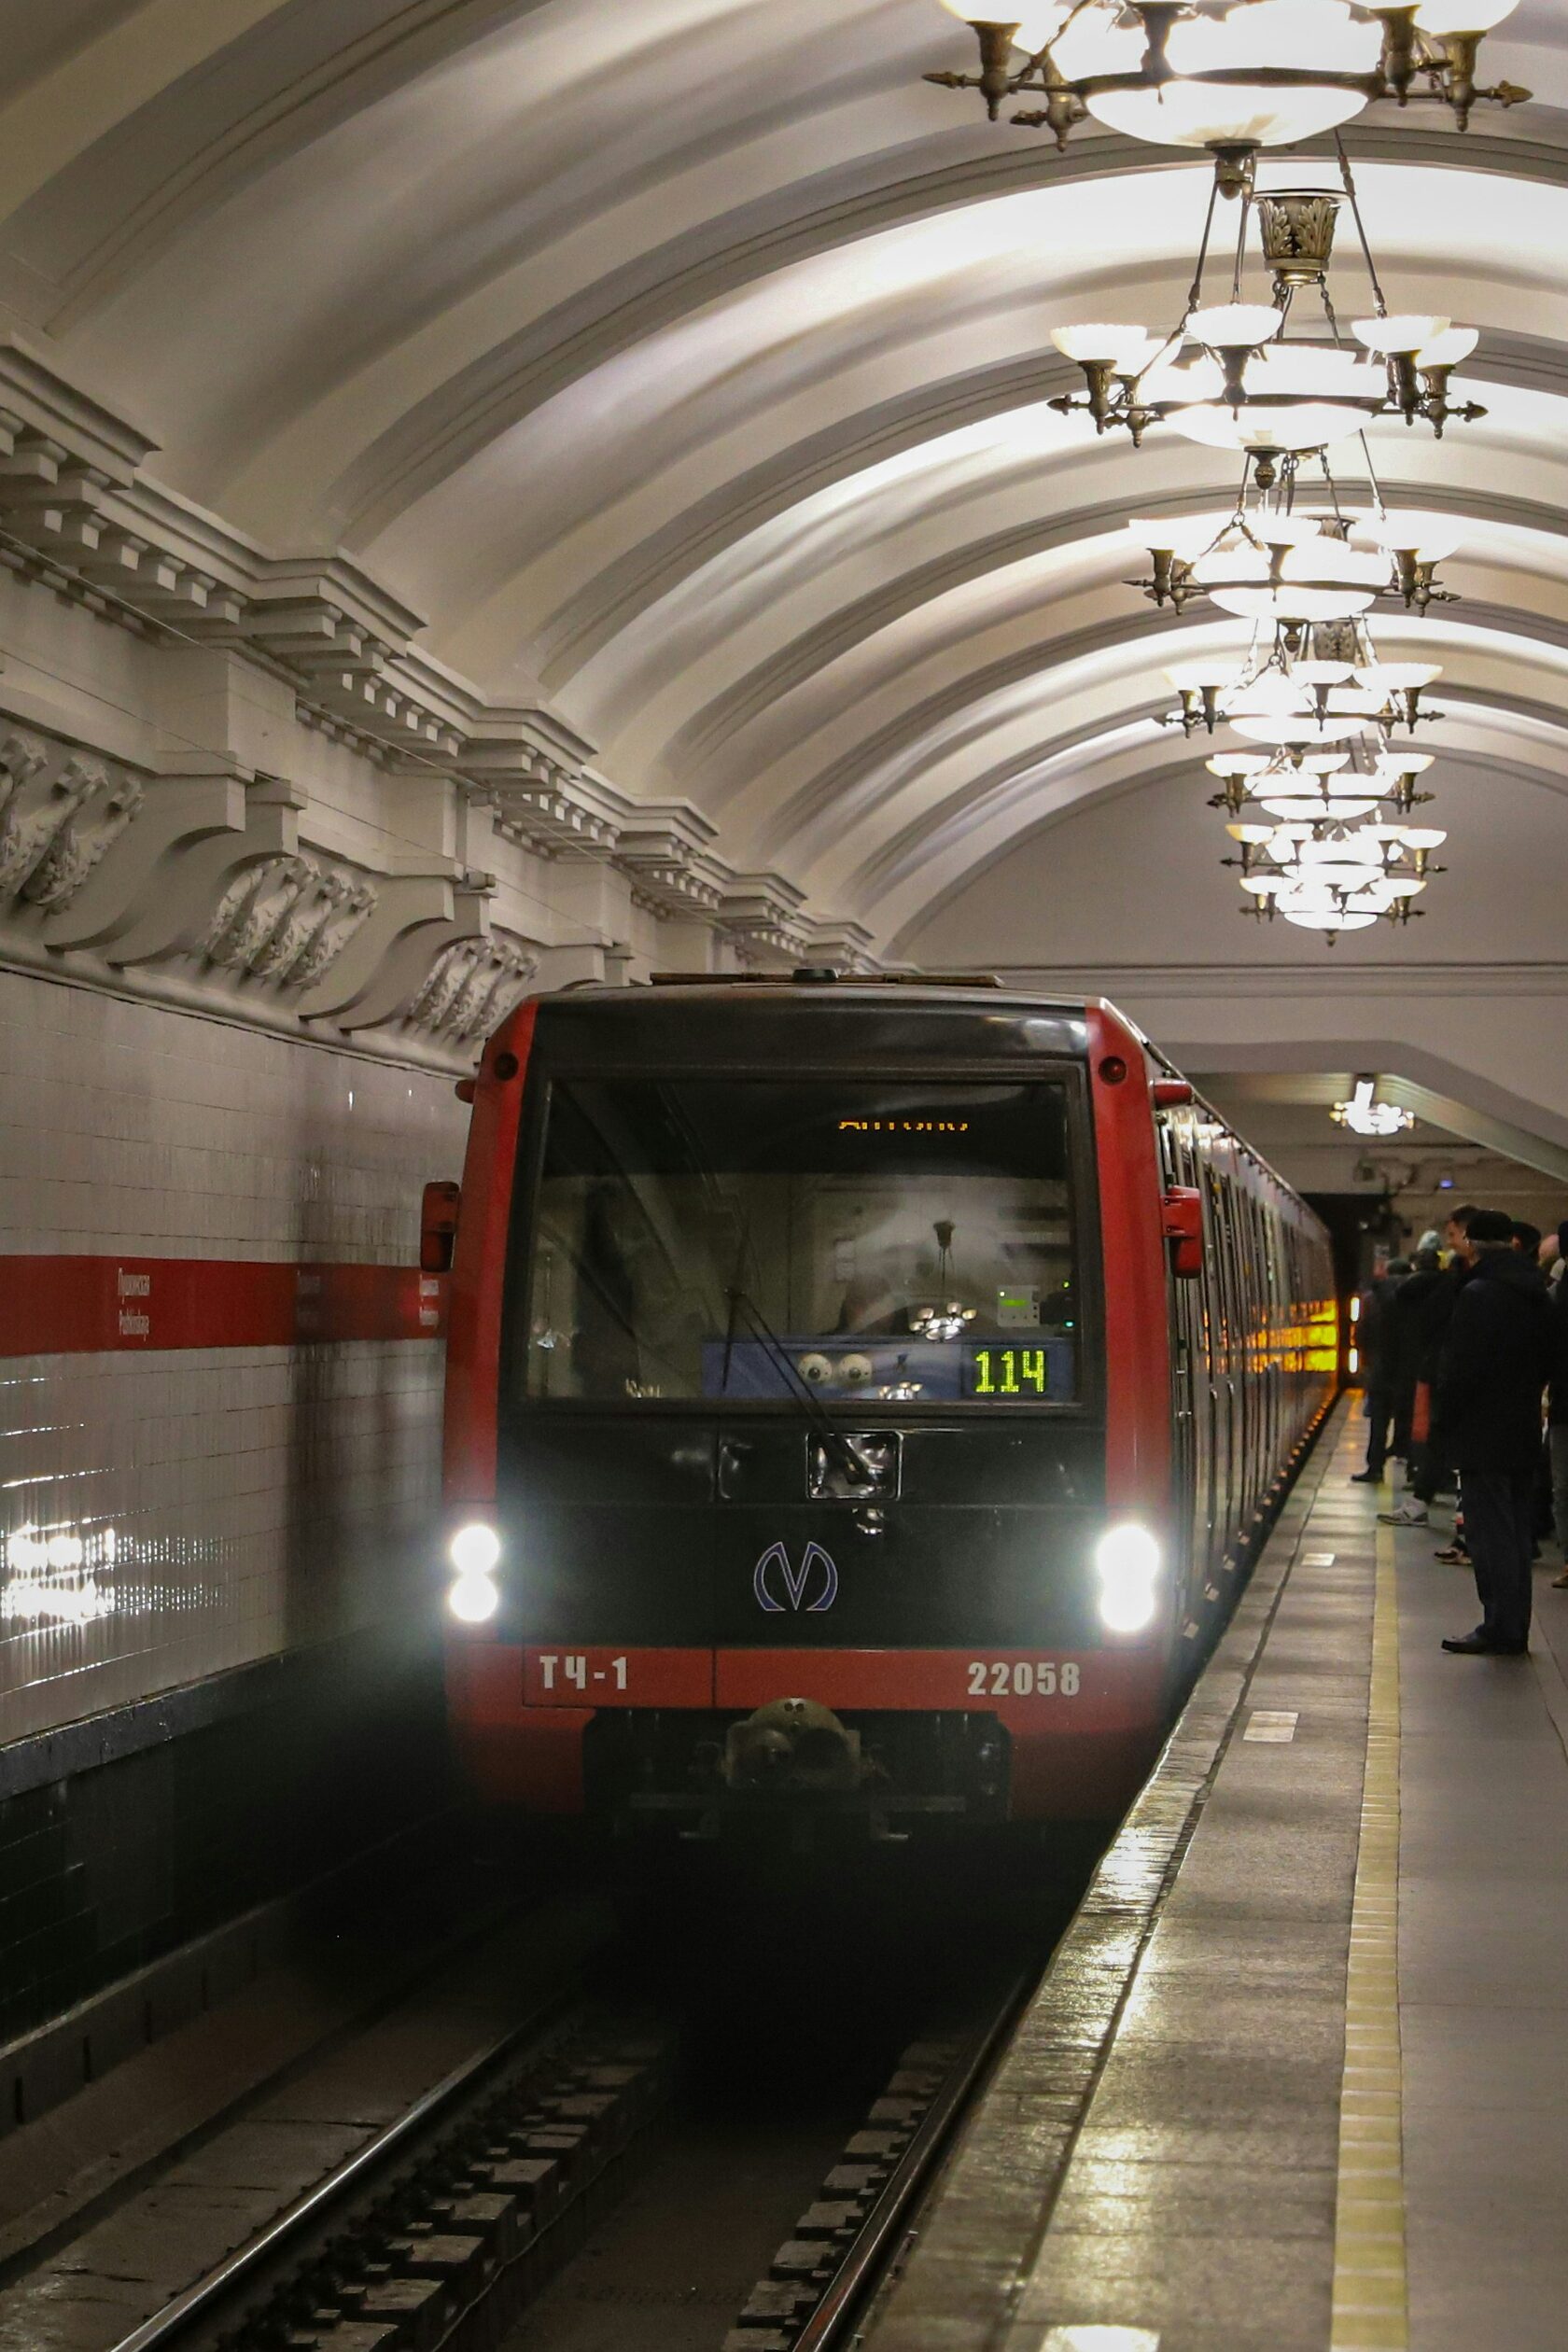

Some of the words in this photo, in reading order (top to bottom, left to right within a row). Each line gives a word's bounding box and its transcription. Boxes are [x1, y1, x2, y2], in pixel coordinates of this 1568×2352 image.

[975, 1351, 1044, 1393] 114
[539, 1655, 628, 1690] ТЧ-1
[967, 1661, 1081, 1697] 22058
